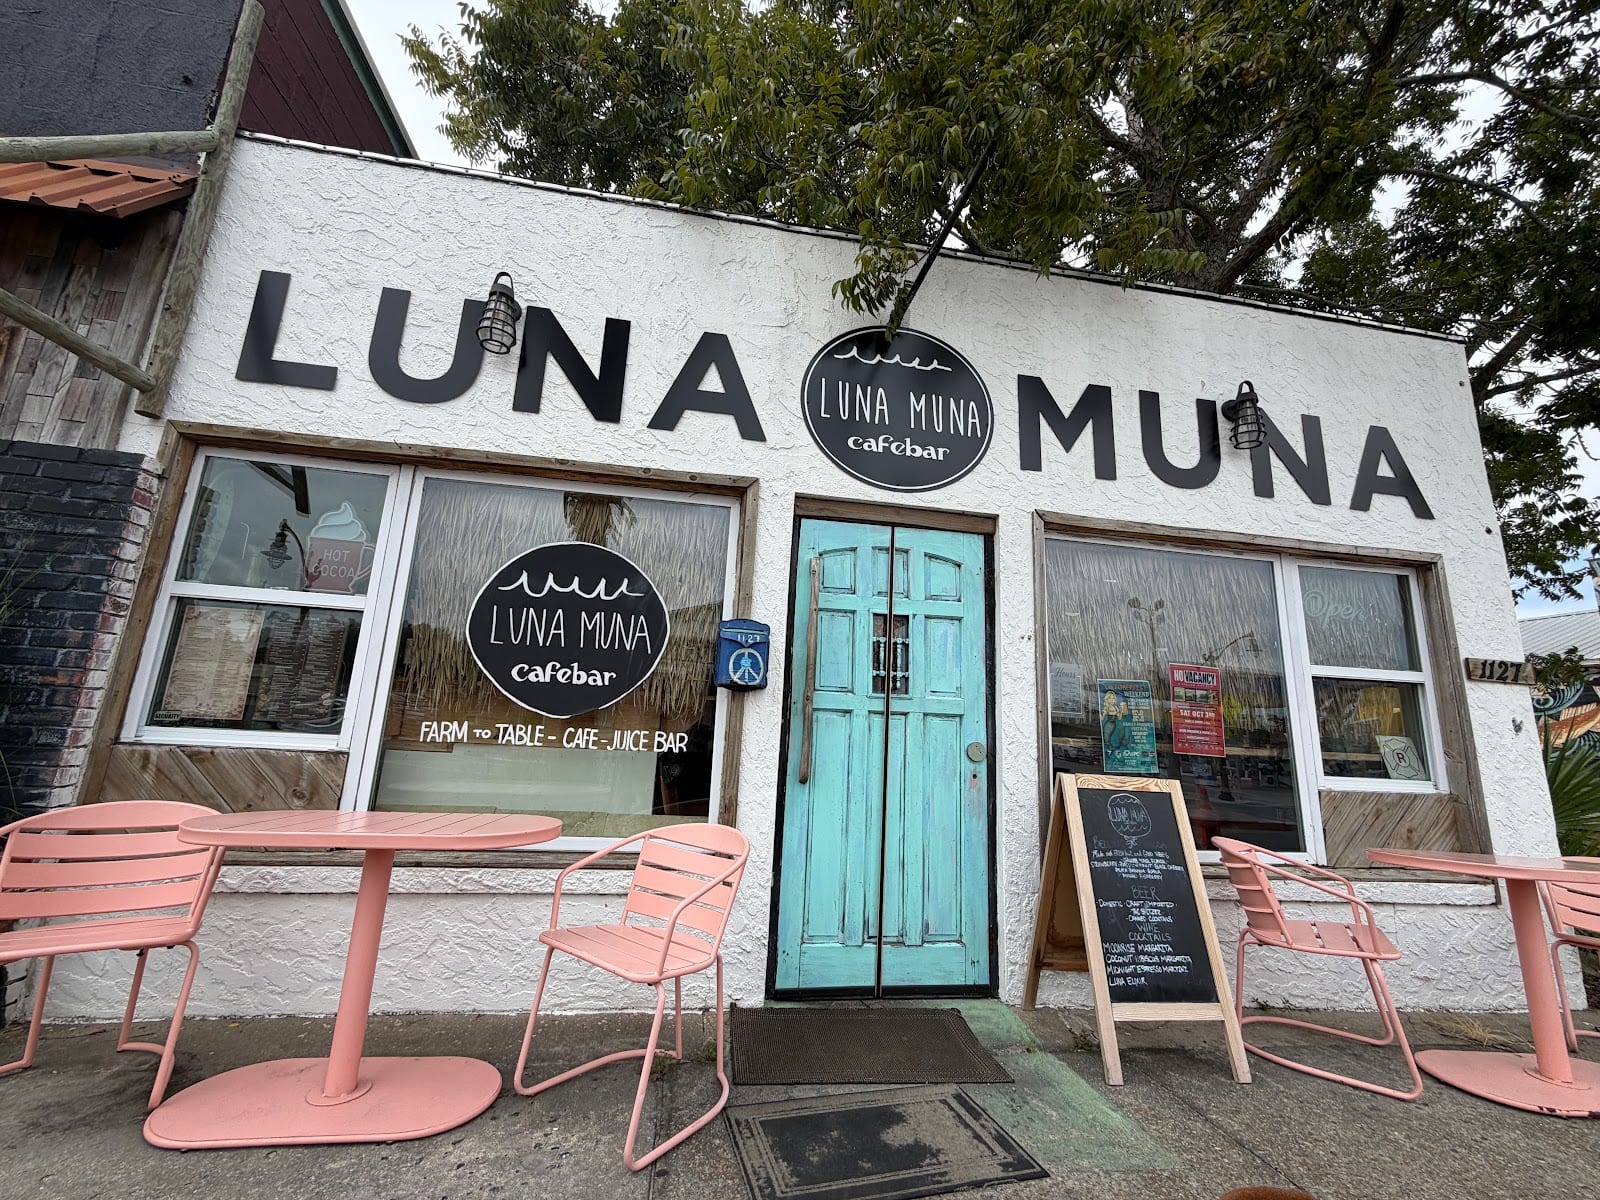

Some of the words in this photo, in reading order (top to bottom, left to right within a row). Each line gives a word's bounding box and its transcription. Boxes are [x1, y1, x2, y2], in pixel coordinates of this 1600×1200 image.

[236, 270, 766, 442] LUNA
[1017, 374, 1435, 520] MUNA
[820, 377, 889, 425] LUNA
[909, 391, 981, 438] MUNA
[847, 434, 950, 461] cafebar
[323, 549, 351, 563] HOT
[311, 563, 356, 578] COCOA
[490, 605, 565, 647] LUNA
[580, 610, 651, 654] MUNA
[737, 633, 760, 643] 1127
[511, 661, 616, 686] cafebar
[1184, 671, 1215, 685] VACANCY
[1480, 659, 1523, 682] 1127
[419, 721, 468, 743] FARM
[495, 723, 545, 746] TABLE
[562, 727, 599, 749] CAFE
[606, 730, 649, 751] JUICE
[653, 732, 688, 753] BAR
[1396, 752, 1408, 764] R
[1131, 885, 1160, 901] BEER
[1136, 922, 1160, 933] WINE
[1128, 932, 1172, 941] COCKTAILS
[1137, 943, 1173, 953] MARGARITA
[1106, 954, 1134, 963] COCONUT
